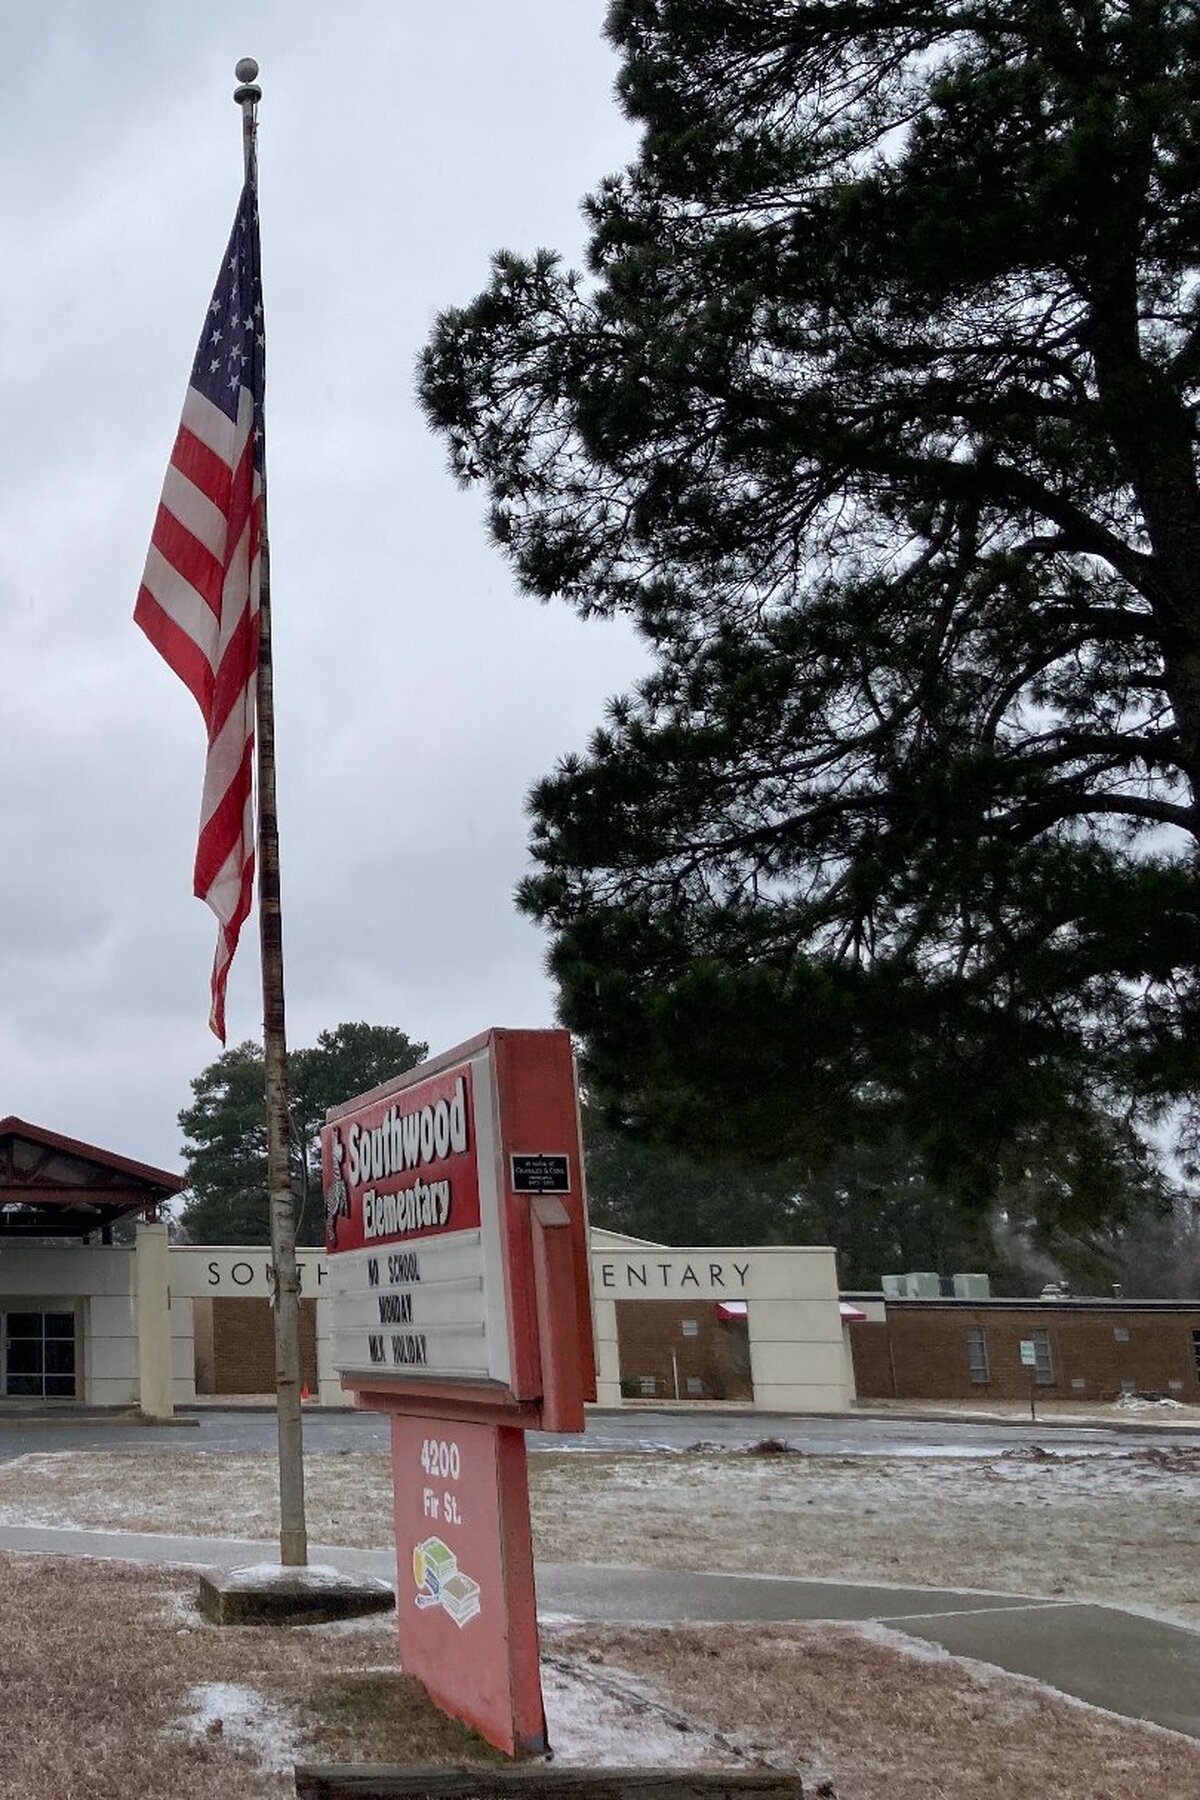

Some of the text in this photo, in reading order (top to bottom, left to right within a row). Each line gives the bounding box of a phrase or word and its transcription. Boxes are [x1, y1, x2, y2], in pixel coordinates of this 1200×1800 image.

[349, 1076, 467, 1187] Southwood
[363, 1177, 450, 1240] Elementary
[367, 1253, 420, 1286] NO SCHOOL
[378, 1293, 413, 1324] MONDAY
[391, 1334, 427, 1364] HOLIDAY
[421, 1439, 460, 1481] 4200
[423, 1487, 462, 1525] Fir St.
